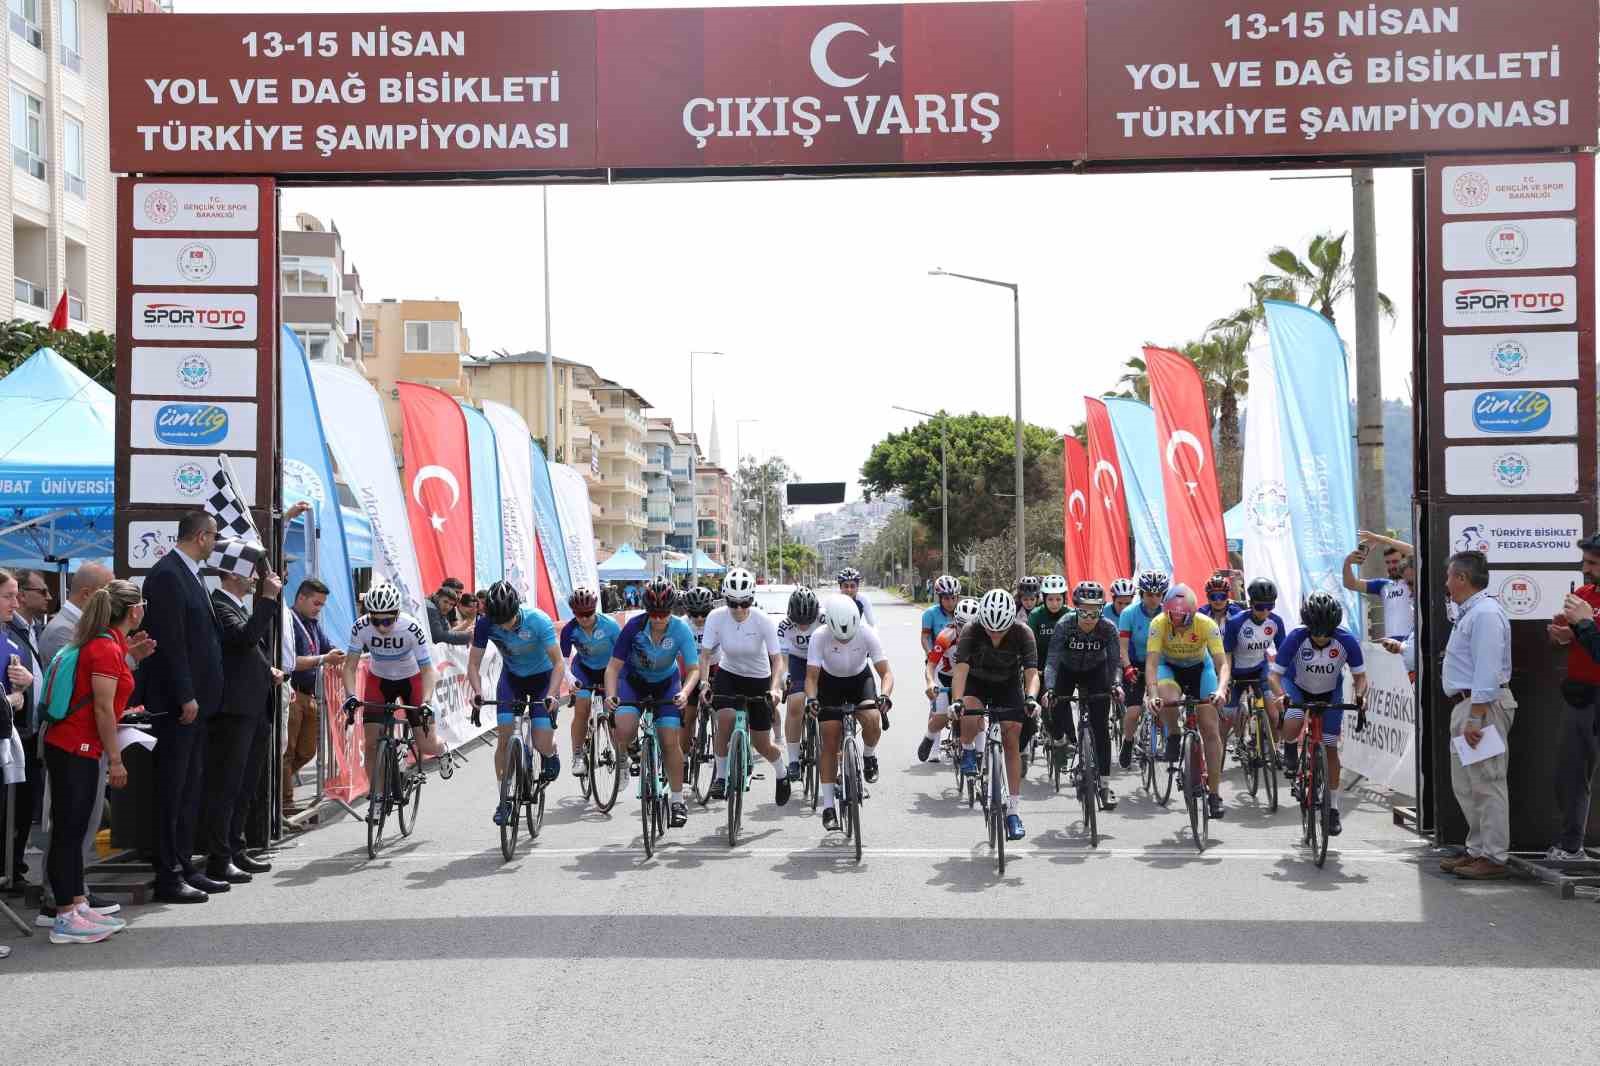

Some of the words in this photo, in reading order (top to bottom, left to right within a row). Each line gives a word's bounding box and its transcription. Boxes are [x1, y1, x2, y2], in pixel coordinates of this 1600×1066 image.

[1225, 11, 1324, 40] 13-15
[1338, 3, 1459, 36] NİSAN
[242, 31, 338, 58] 13-15
[351, 25, 465, 57] NİSAN
[1125, 63, 1200, 90] YOL
[1211, 61, 1261, 88] VE
[1275, 52, 1353, 86] DAĞ
[1367, 44, 1560, 84] BİSİKLETİ
[144, 78, 219, 105] YOL
[229, 78, 278, 105] VE
[291, 71, 366, 104] DAĞ
[379, 70, 561, 104] BİSİKLETİ
[682, 92, 1001, 149] ÇIKIŞ-VARIŞ
[1116, 103, 1287, 138] TÜRKİYE
[1299, 97, 1569, 140] ŞAMPİYONASI
[136, 119, 303, 151] TÜRKİYE
[315, 118, 569, 157] ŞAMPİYONASI
[1455, 293, 1565, 310] SPORTOTO
[144, 309, 246, 324] SPORTOTO
[41, 476, 115, 495] ÜNİVERSİT
[1489, 527, 1532, 537] TÜRKİYE
[1535, 527, 1577, 537] BİSİKLET
[1497, 541, 1571, 549] FEDERASYONU
[371, 635, 405, 650] DEU
[407, 622, 426, 646] DEU
[1305, 661, 1335, 674] KMÜ
[1384, 687, 1416, 724] BİSİKL
